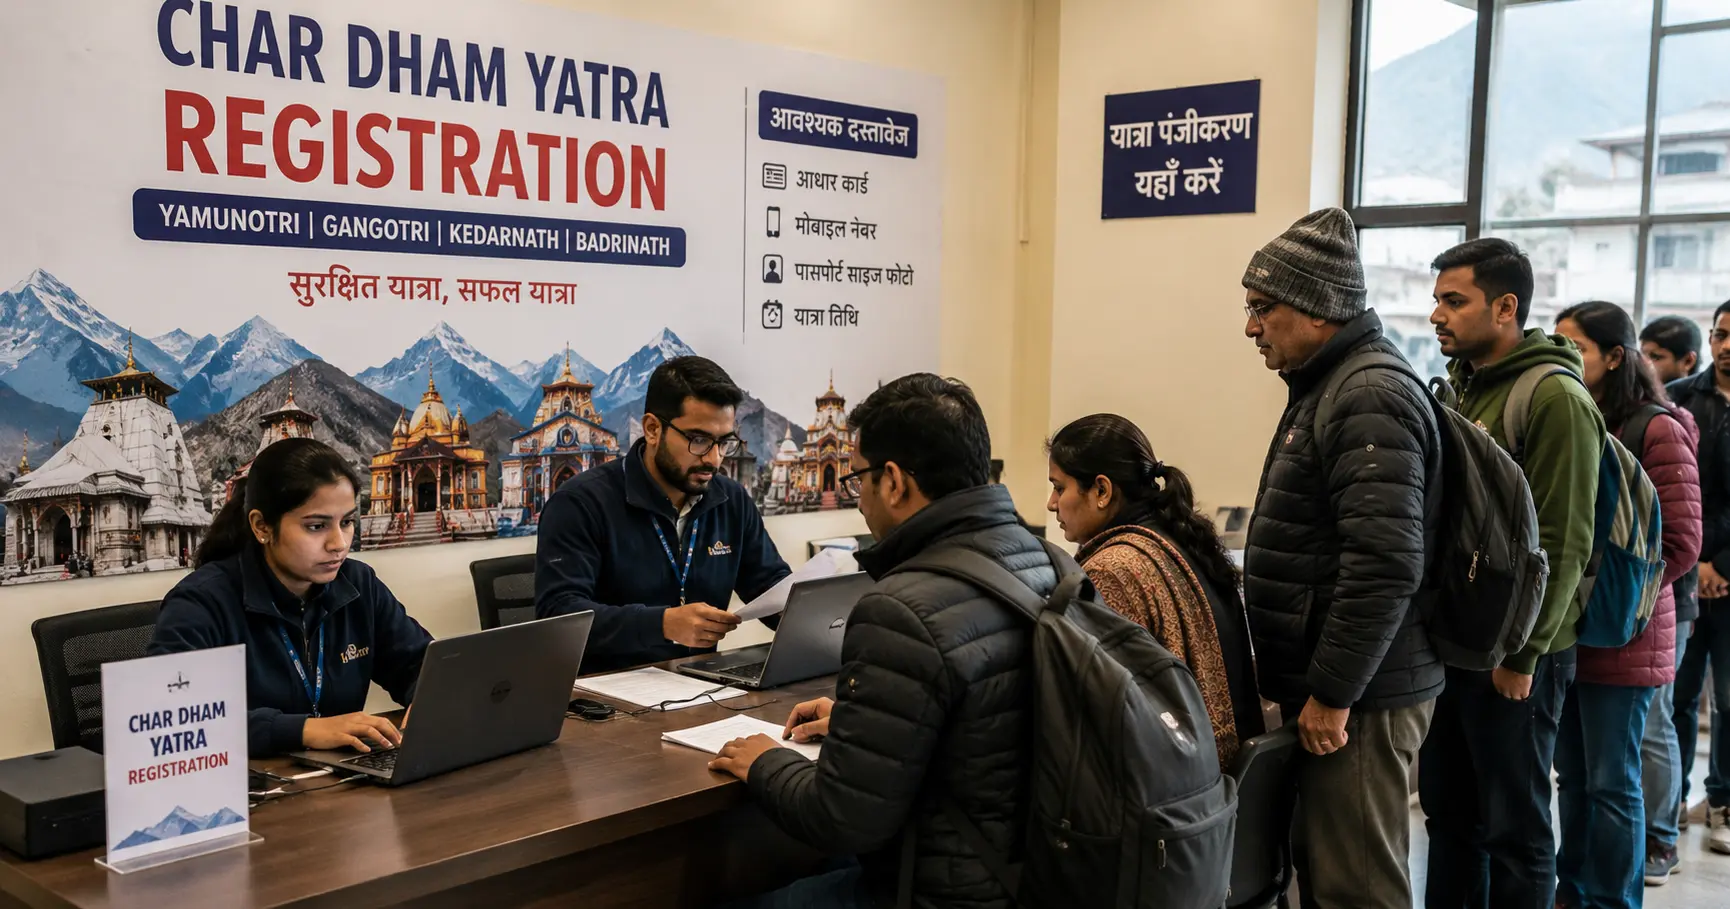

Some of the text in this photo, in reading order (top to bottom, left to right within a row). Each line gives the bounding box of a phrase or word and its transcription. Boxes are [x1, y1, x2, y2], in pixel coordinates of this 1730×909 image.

[157, 0, 670, 129] CHAR DHAM YATRA
[769, 107, 910, 147] आवश्यक दस्तावेज
[1109, 107, 1254, 149] यात्रा पंजीकरण
[164, 89, 666, 211] REGISTRATION
[796, 170, 870, 195] आधार कार्ड
[1134, 156, 1224, 201] यहाँ करें
[158, 203, 670, 256] YAMUNOTRI GANGOTRI KEDARNATH BADRINATH
[794, 211, 847, 241] मोबाइल
[287, 263, 577, 307] सुरक्षित यात्रा, सफल यात्रा
[794, 258, 915, 287] पासपोर्ट साइज फोटो
[793, 303, 860, 327] यात्रा तिथि
[128, 700, 226, 734] CHAR DHAM
[149, 727, 208, 758] YATRA
[128, 751, 229, 785] REGISTRATION
